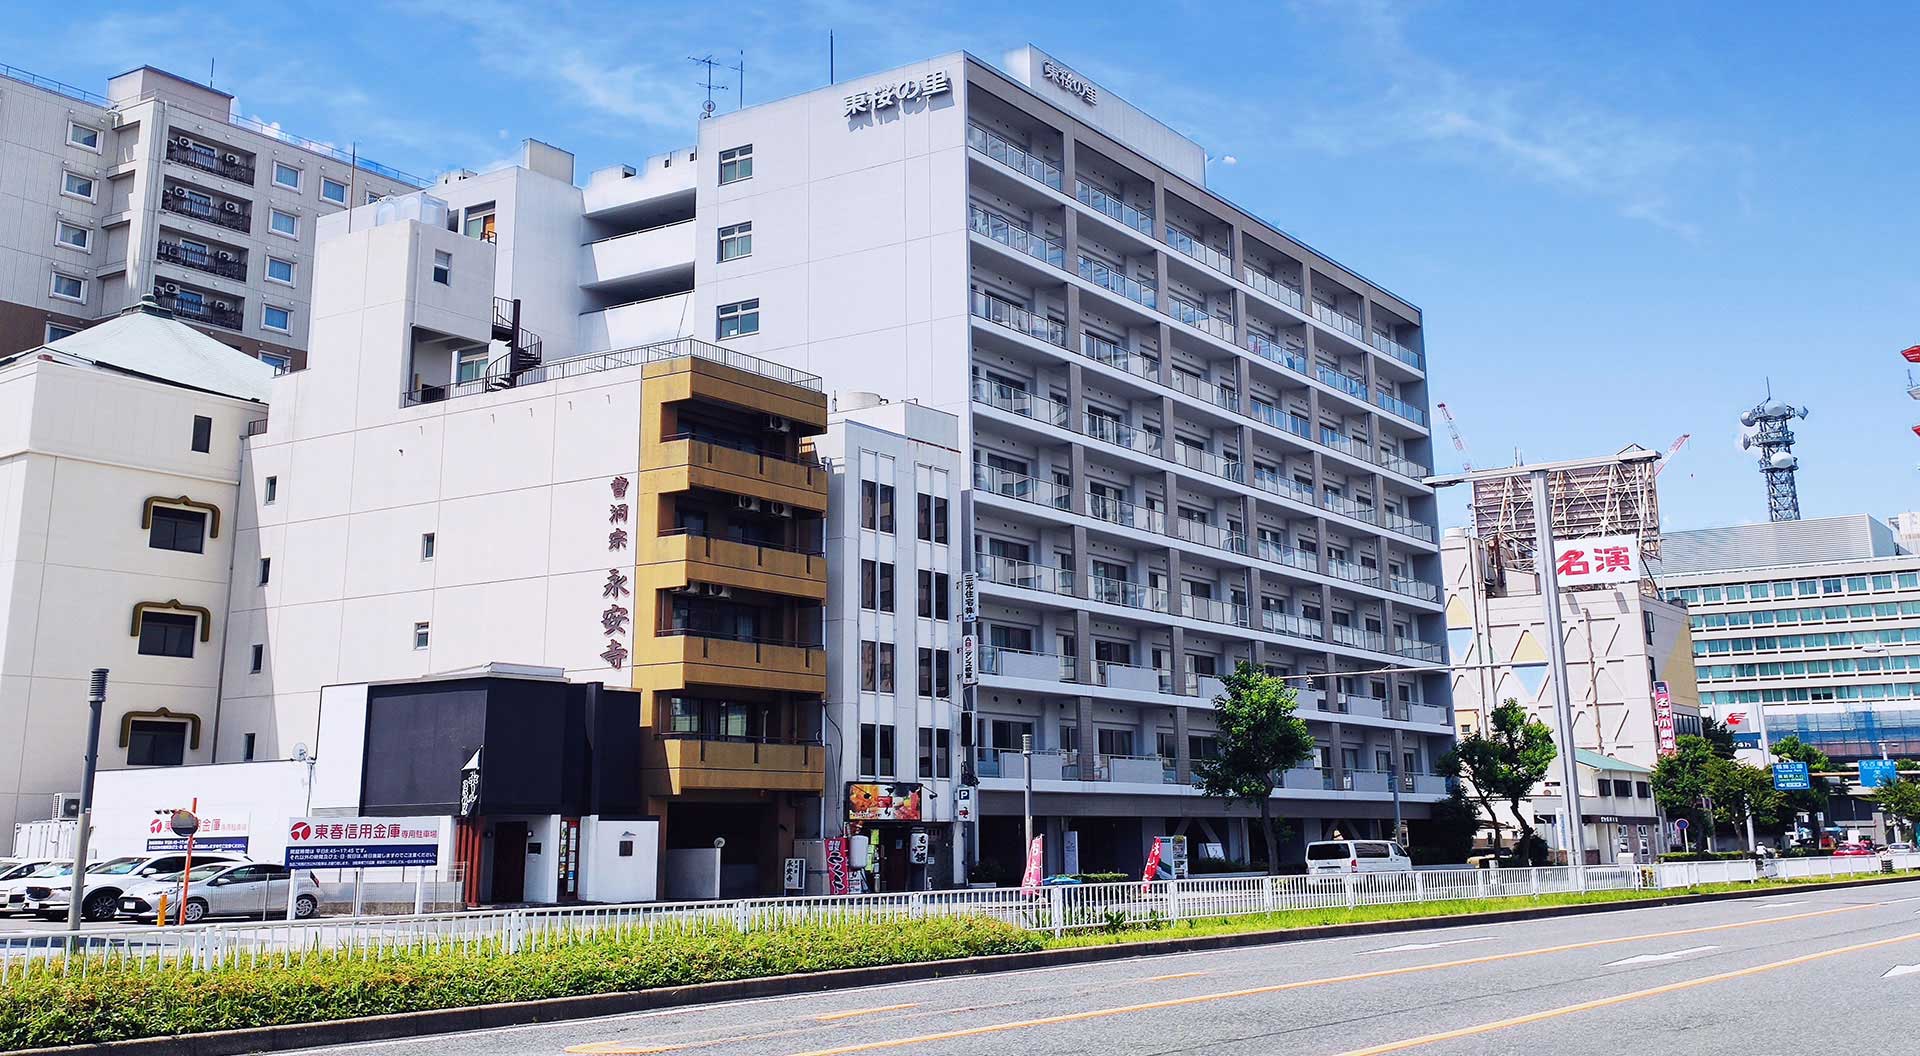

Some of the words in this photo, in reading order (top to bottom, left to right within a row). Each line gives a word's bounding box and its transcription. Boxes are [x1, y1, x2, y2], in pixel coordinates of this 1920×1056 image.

[843, 70, 950, 118] 東桜の里
[1042, 60, 1097, 105] 東桜の里
[608, 476, 629, 551] 曹洞宗
[1556, 546, 1631, 576] 名演
[600, 568, 630, 670] 永安寺
[960, 791, 968, 799] P
[314, 823, 400, 840] 東春信用金庫
[401, 829, 438, 839] 専用駐車場
